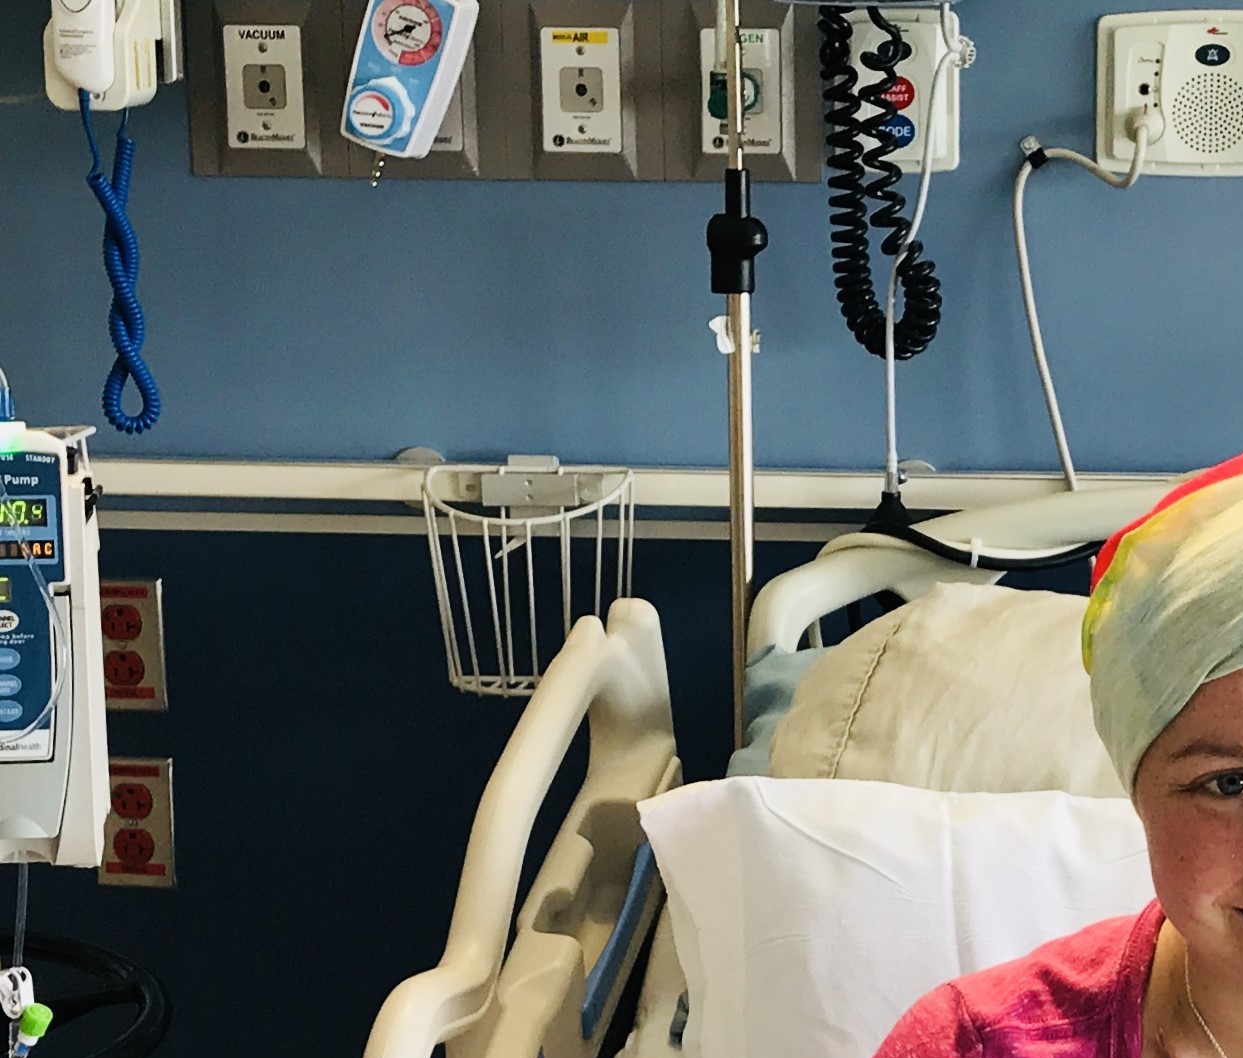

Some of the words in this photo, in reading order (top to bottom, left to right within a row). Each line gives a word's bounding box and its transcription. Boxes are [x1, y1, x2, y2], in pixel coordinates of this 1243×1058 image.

[238, 29, 286, 40] VACUUM
[573, 32, 590, 42] AIR
[4, 475, 39, 487] Pump
